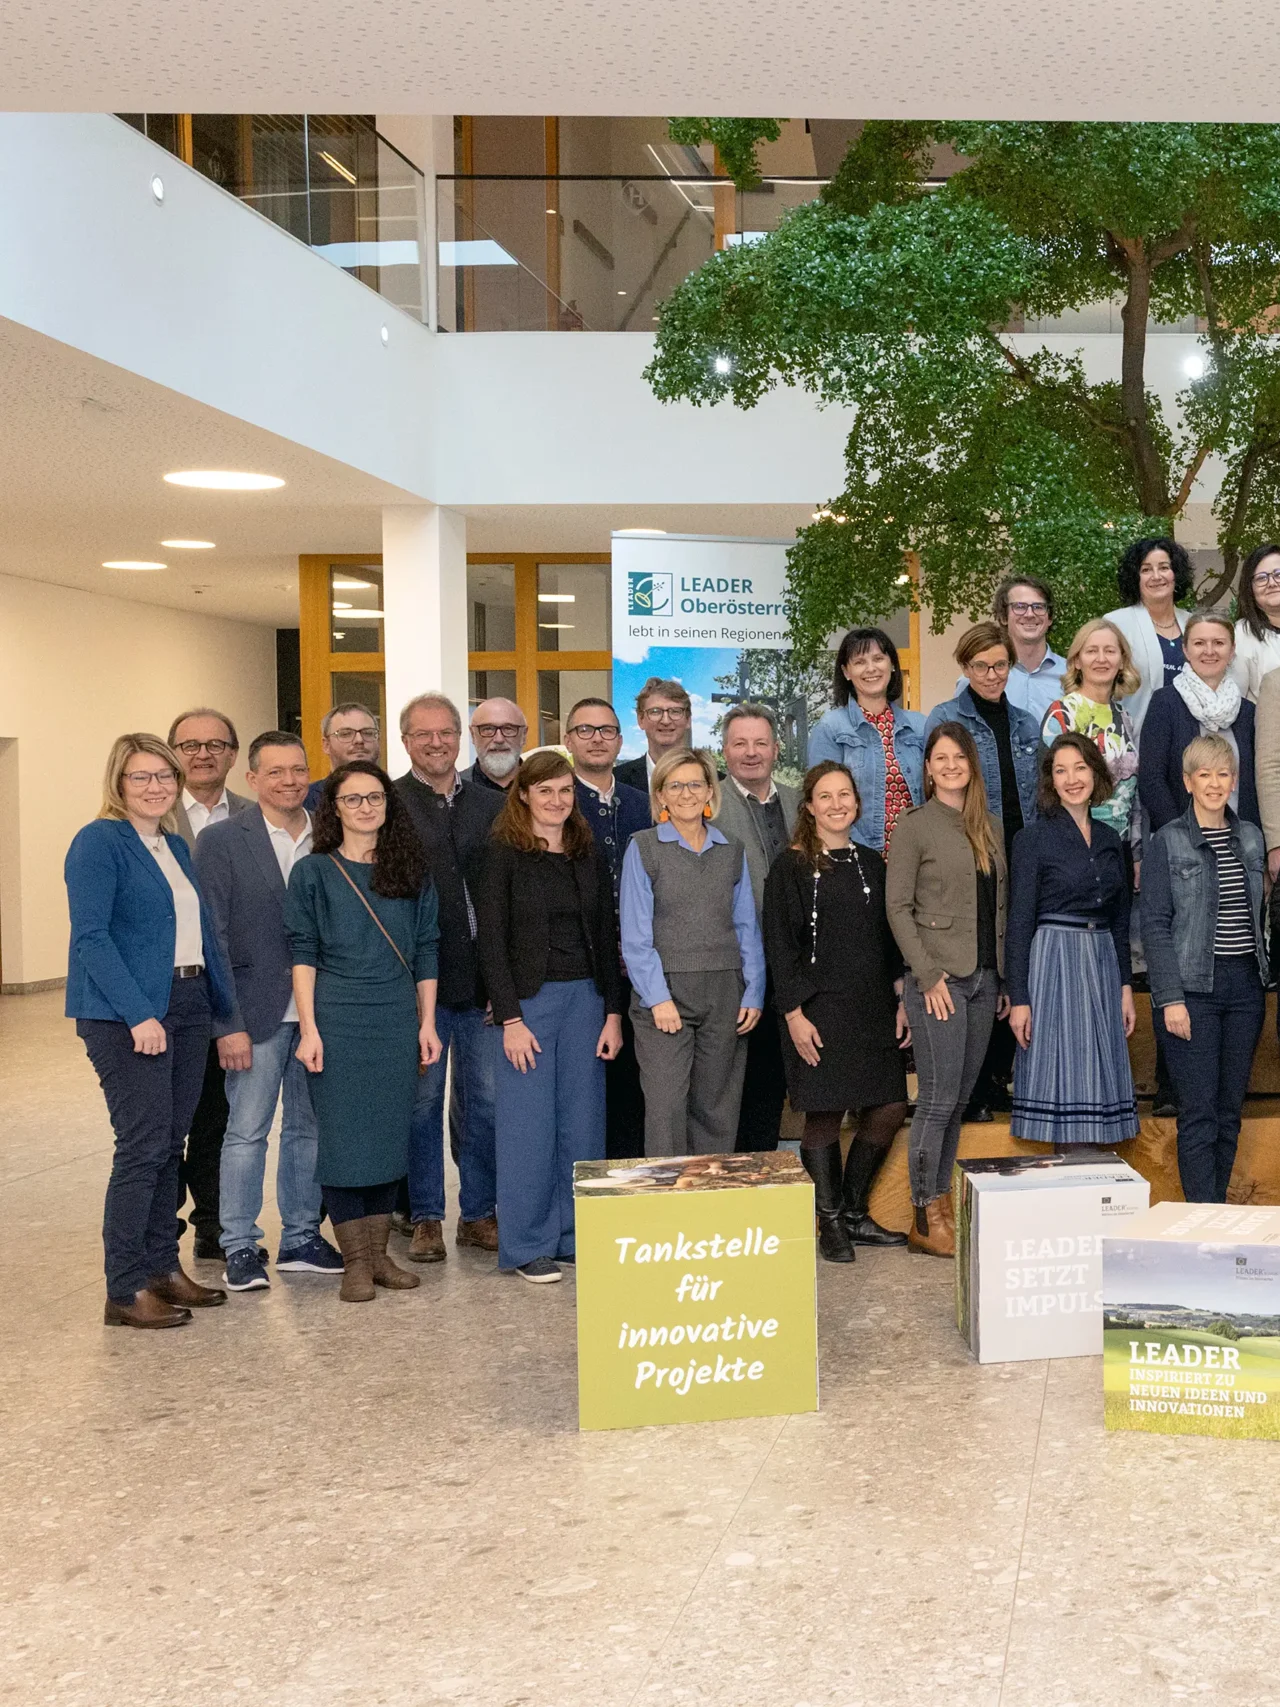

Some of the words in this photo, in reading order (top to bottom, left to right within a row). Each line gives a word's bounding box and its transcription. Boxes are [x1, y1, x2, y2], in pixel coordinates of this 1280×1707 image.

[681, 577, 753, 594] LEADER
[680, 598, 792, 616] Oberösterre
[629, 625, 654, 638] lebt
[658, 626, 670, 638] in
[674, 627, 717, 639] seinen
[615, 1226, 781, 1265] Tankstelle
[675, 1273, 724, 1303] für
[1005, 1263, 1089, 1290] SETZT
[1005, 1290, 1103, 1318] IMPULS
[618, 1313, 779, 1349] innovative
[1129, 1341, 1241, 1370] LEADER
[634, 1354, 765, 1396] Projekte
[1129, 1368, 1213, 1385] INSPIRIERT
[1215, 1374, 1235, 1387] ZU
[1129, 1384, 1181, 1399] NEUEN
[1184, 1387, 1230, 1402] IDEEN
[1234, 1391, 1267, 1404] UND
[1129, 1399, 1245, 1418] INNOVATIONEN
